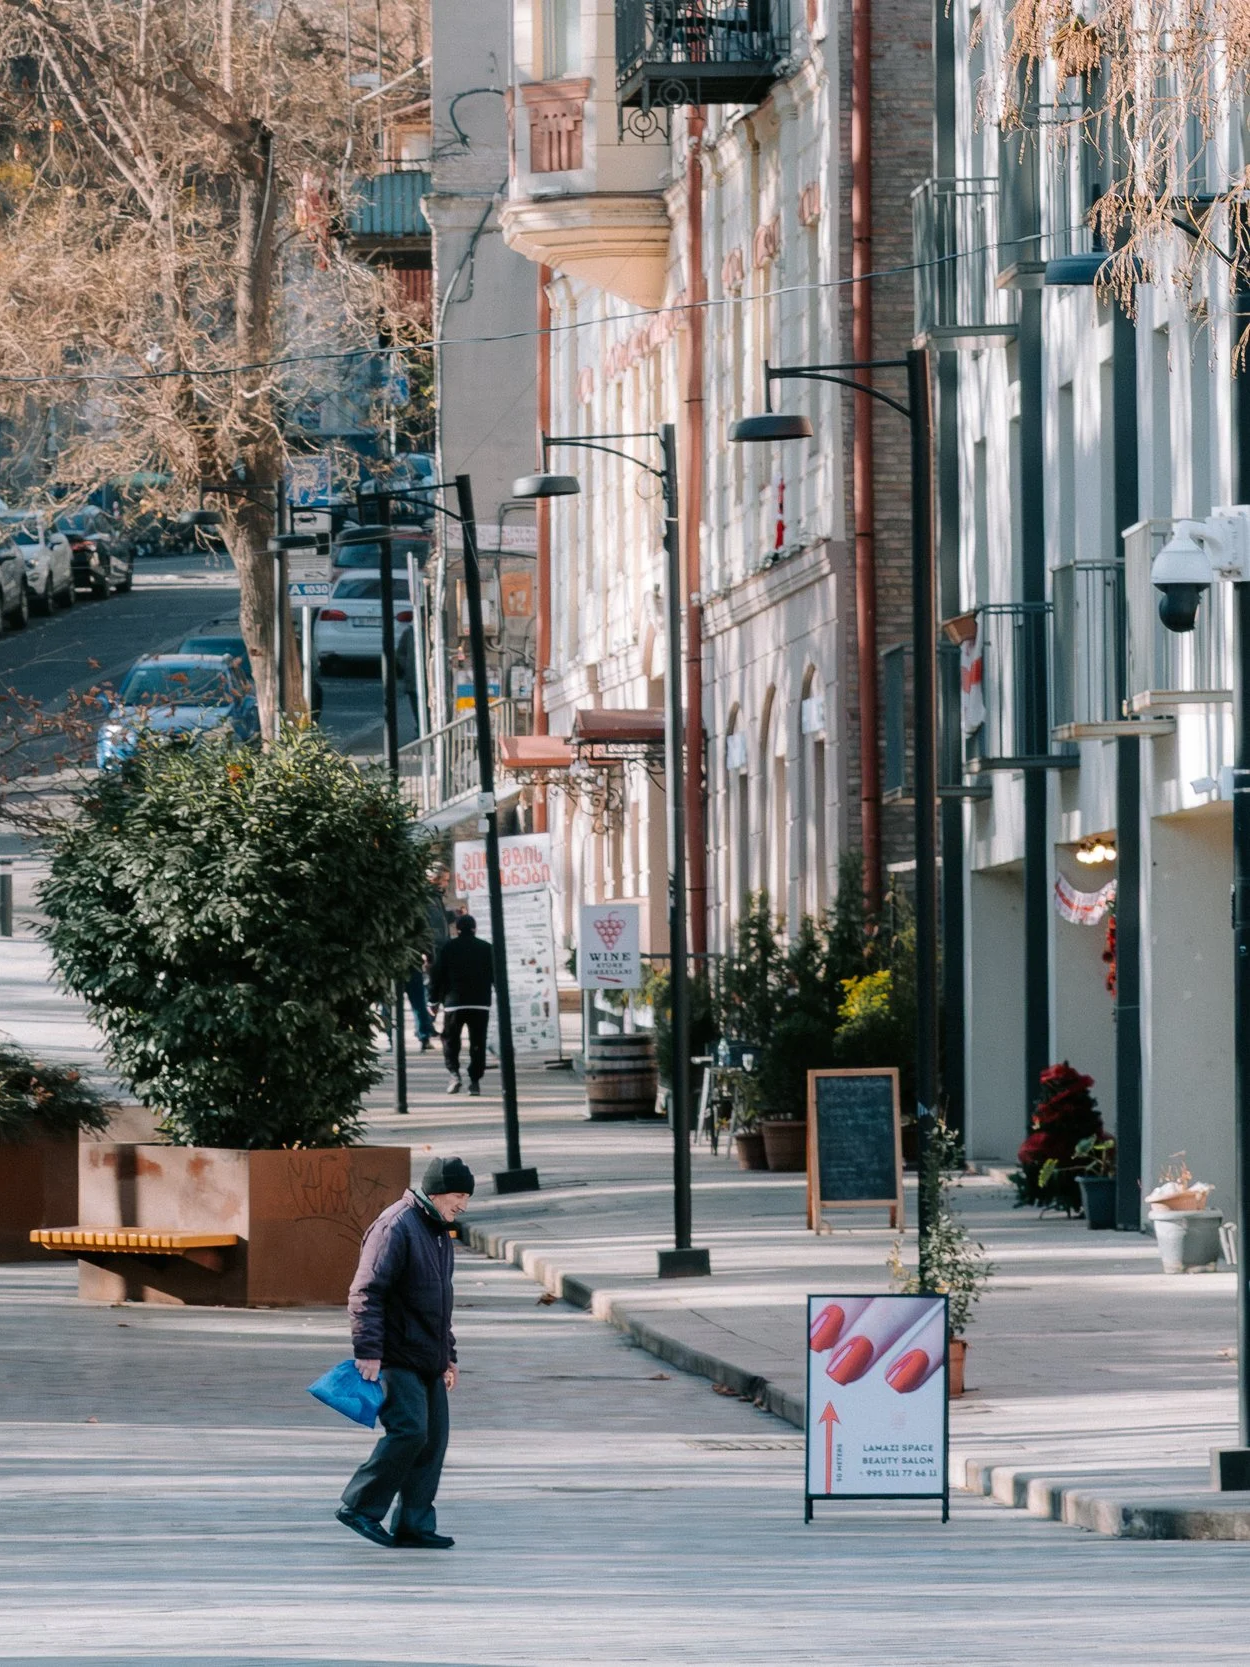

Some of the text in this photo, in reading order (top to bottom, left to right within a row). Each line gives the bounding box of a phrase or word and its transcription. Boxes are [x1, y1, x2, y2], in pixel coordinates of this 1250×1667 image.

[454, 863, 550, 892] ხელსნები
[589, 952, 631, 961] WINE
[863, 1444, 934, 1452] LAMAZI SPACE
[862, 1457, 935, 1465] BEAUTY SALON
[866, 1469, 883, 1477] 995
[902, 1469, 912, 1477] 77
